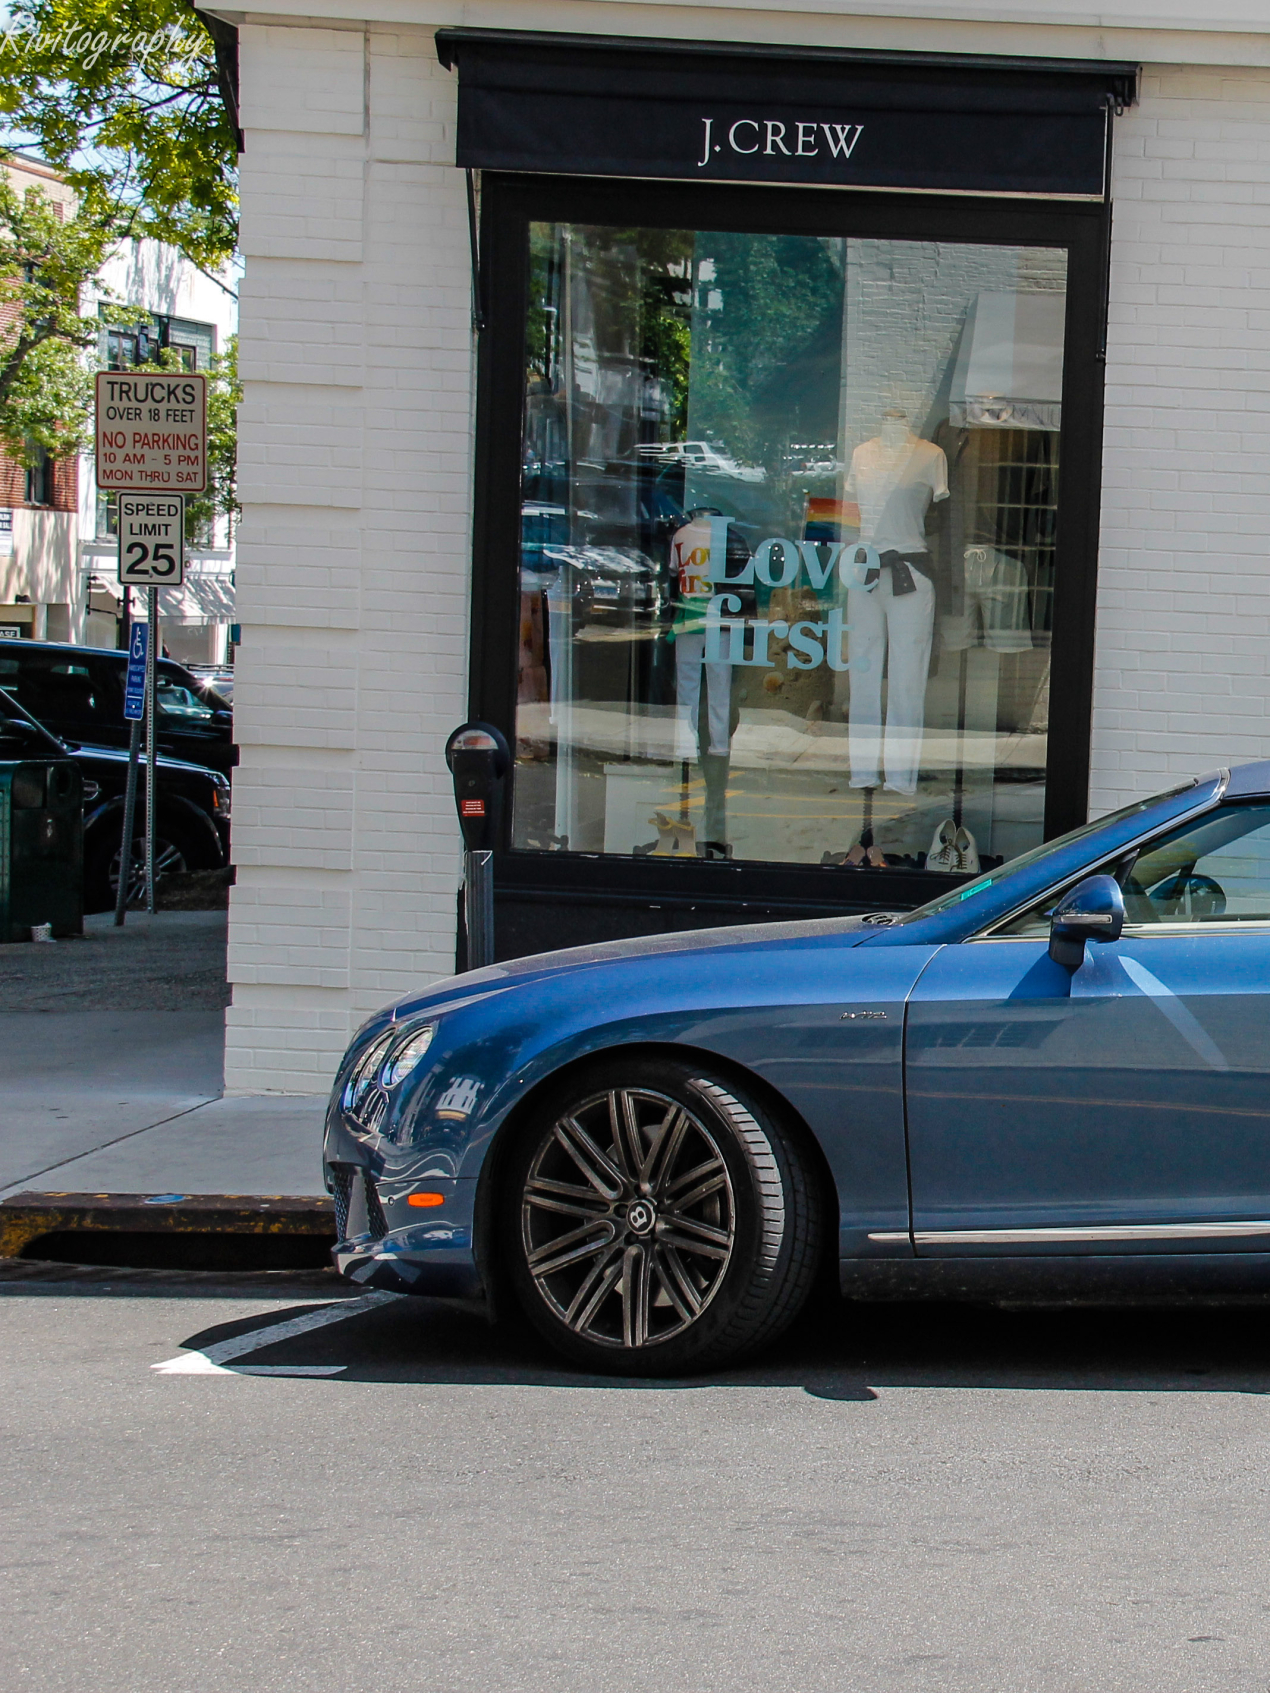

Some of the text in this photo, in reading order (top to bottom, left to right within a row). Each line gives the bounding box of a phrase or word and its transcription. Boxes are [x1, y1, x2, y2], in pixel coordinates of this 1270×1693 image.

[698, 118, 865, 167] J.CREW
[106, 381, 196, 405] TRUCKS
[106, 406, 196, 423] OVER 18 FEET
[102, 431, 199, 451] NO PARKING
[103, 452, 117, 464] 10
[123, 453, 146, 465] AM
[164, 454, 172, 466] 5
[178, 455, 199, 466] PM
[102, 469, 199, 483] MON THRU SAT
[124, 503, 179, 517] SPEED
[129, 523, 172, 536] LIMIT
[126, 542, 176, 577] 25
[701, 515, 881, 593] Love
